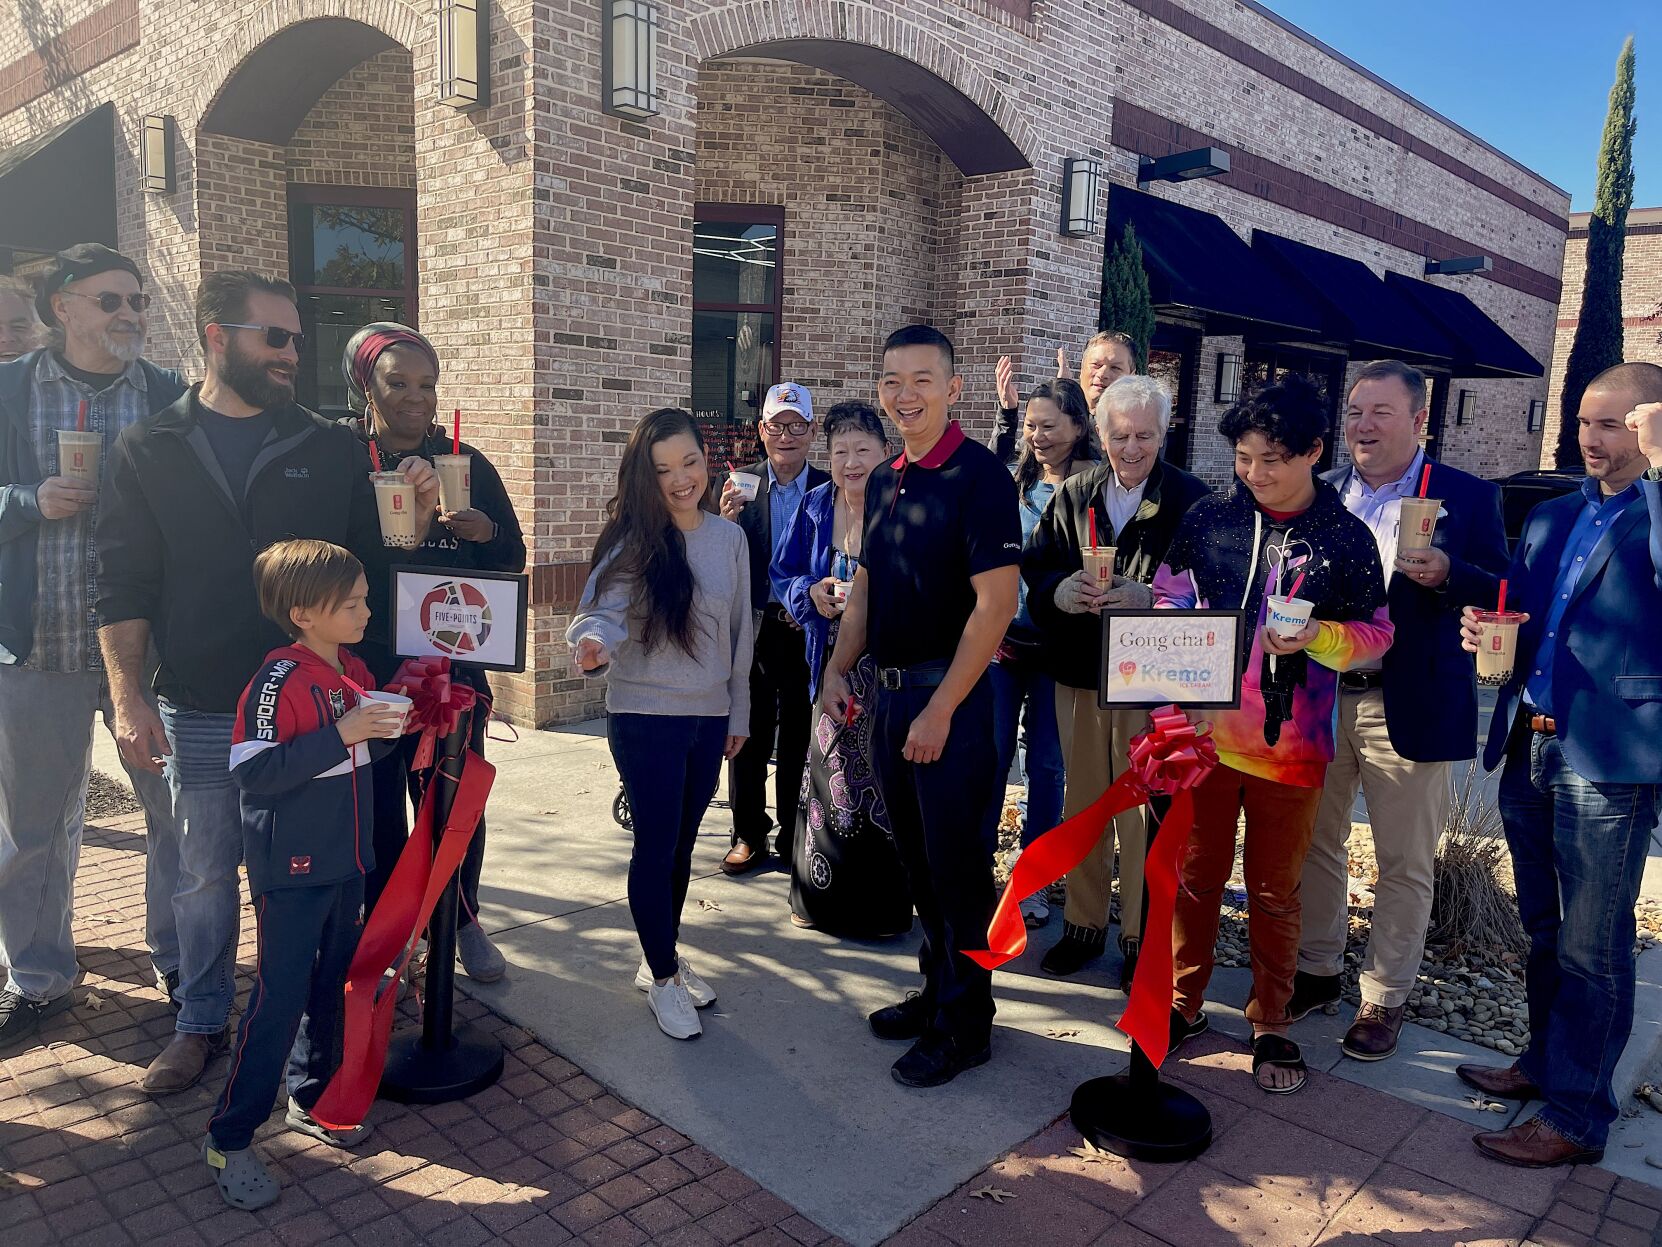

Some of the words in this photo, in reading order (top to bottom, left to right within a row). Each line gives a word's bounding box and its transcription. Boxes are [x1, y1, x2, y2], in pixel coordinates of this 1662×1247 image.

[696, 410, 720, 418] HOURS
[1272, 611, 1307, 625] Kremo
[1119, 631, 1169, 652] Gong
[1172, 631, 1203, 647] cha
[1141, 664, 1212, 682] Kremo
